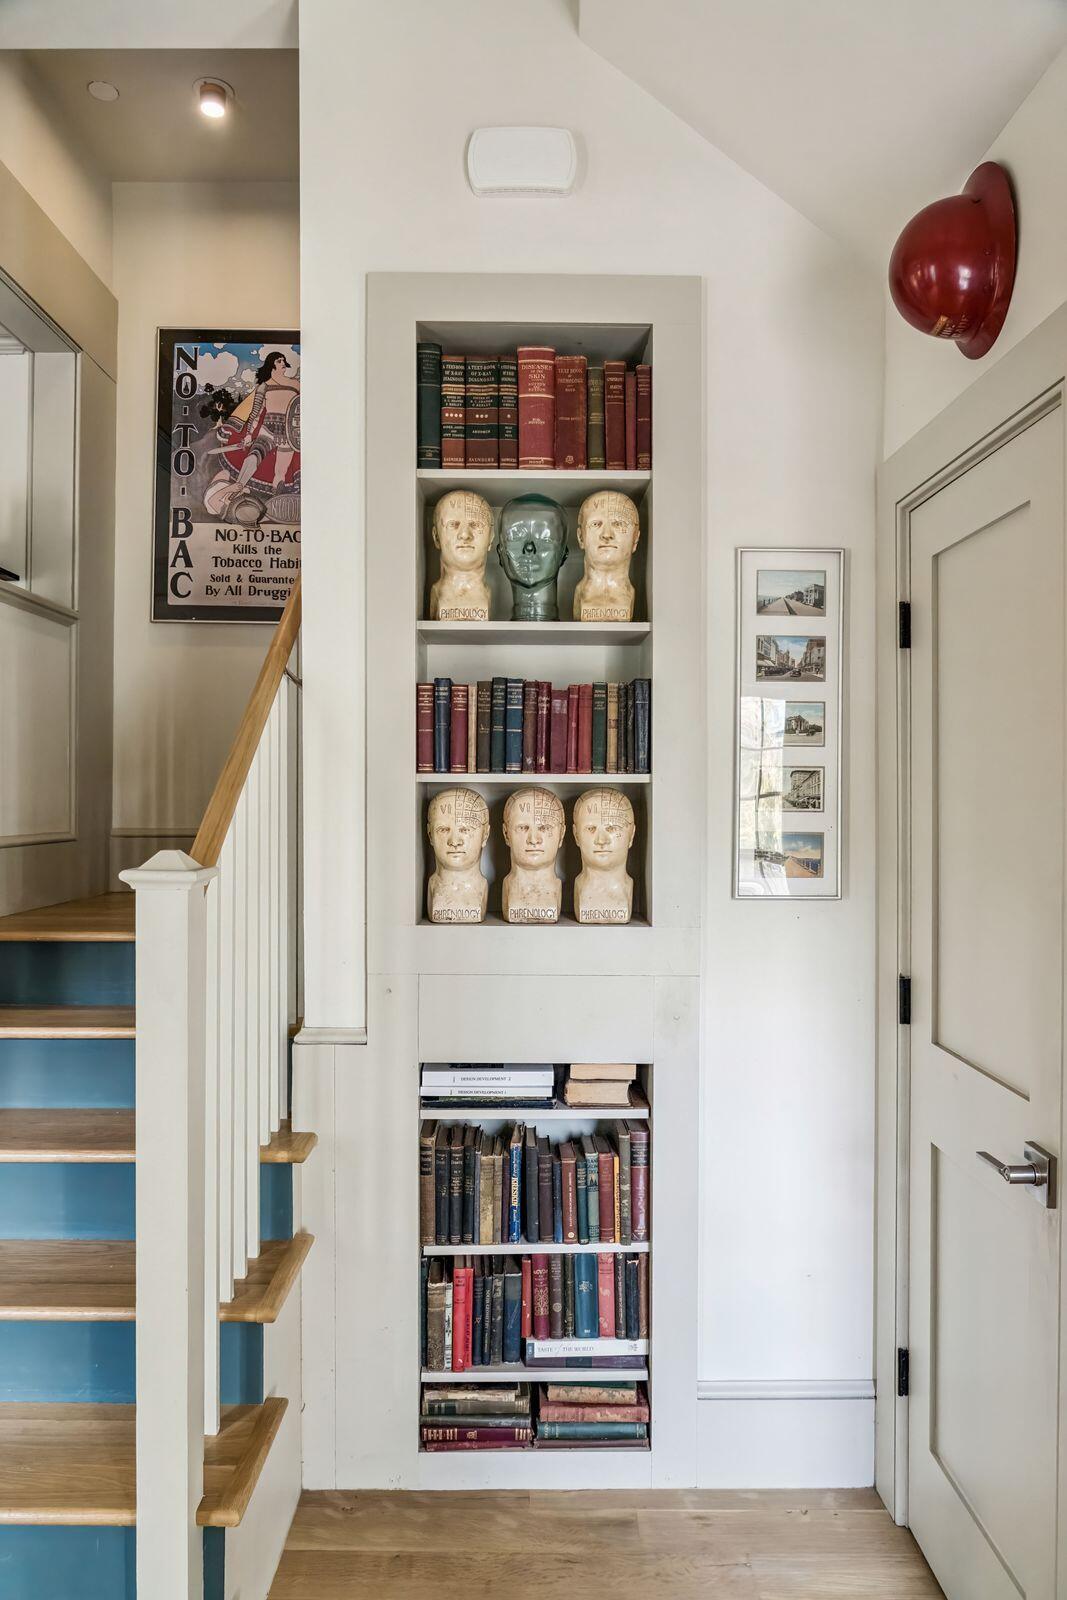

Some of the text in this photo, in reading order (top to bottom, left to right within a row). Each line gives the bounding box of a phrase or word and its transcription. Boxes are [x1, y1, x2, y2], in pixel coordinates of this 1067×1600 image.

[233, 544, 282, 554] Kills the
[212, 556, 262, 568] Tobacco
[210, 574, 294, 584] Sold & Guarante
[206, 585, 291, 600] By All Druggi
[440, 608, 488, 618] PHRENOLOGY
[583, 608, 628, 618] PHRENOLOGY
[433, 909, 480, 919] PHRENOLOGY
[509, 909, 556, 919] PHRENOLOGY
[581, 909, 627, 919] PHRENOLOGY
